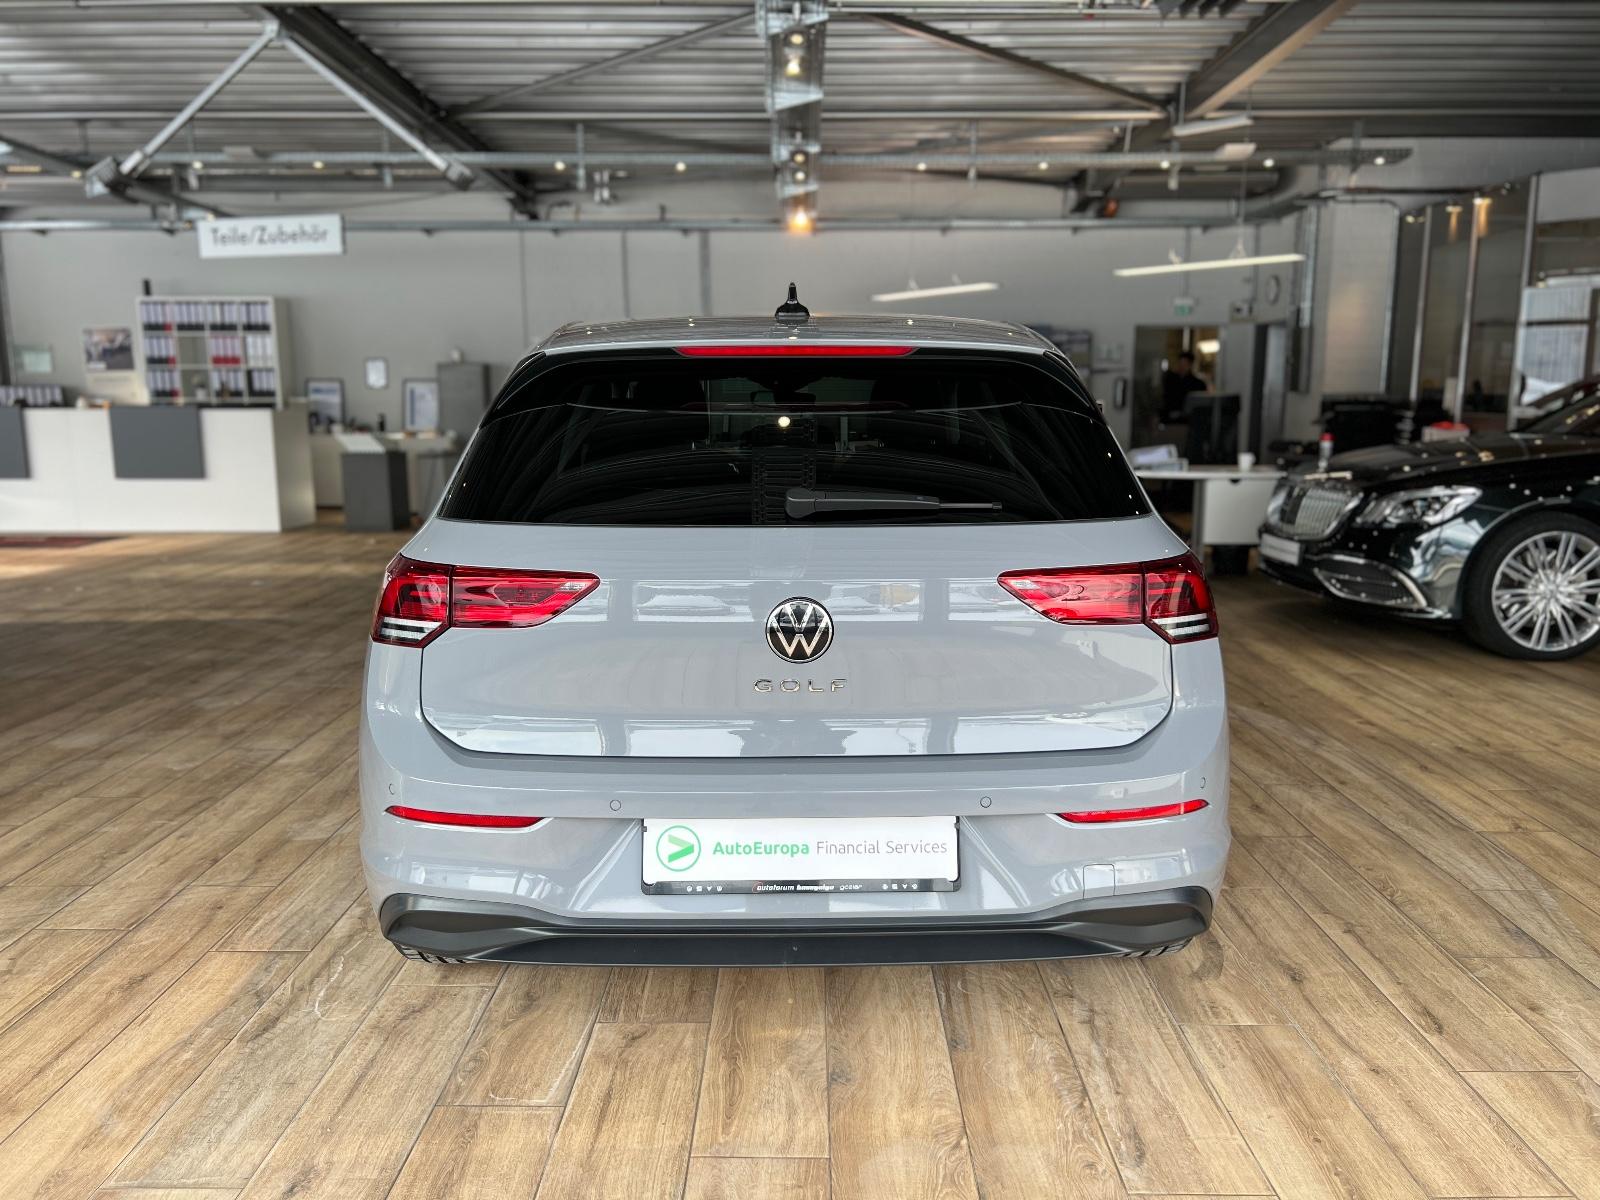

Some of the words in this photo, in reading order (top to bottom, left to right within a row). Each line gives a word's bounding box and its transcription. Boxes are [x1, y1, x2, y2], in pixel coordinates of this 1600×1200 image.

[210, 223, 329, 247] Teile/Zubehör
[769, 599, 831, 661] VW
[753, 679, 848, 692] GOLF
[712, 841, 810, 858] AutoEuropa
[816, 840, 880, 855] Financial
[885, 840, 948, 854] Services
